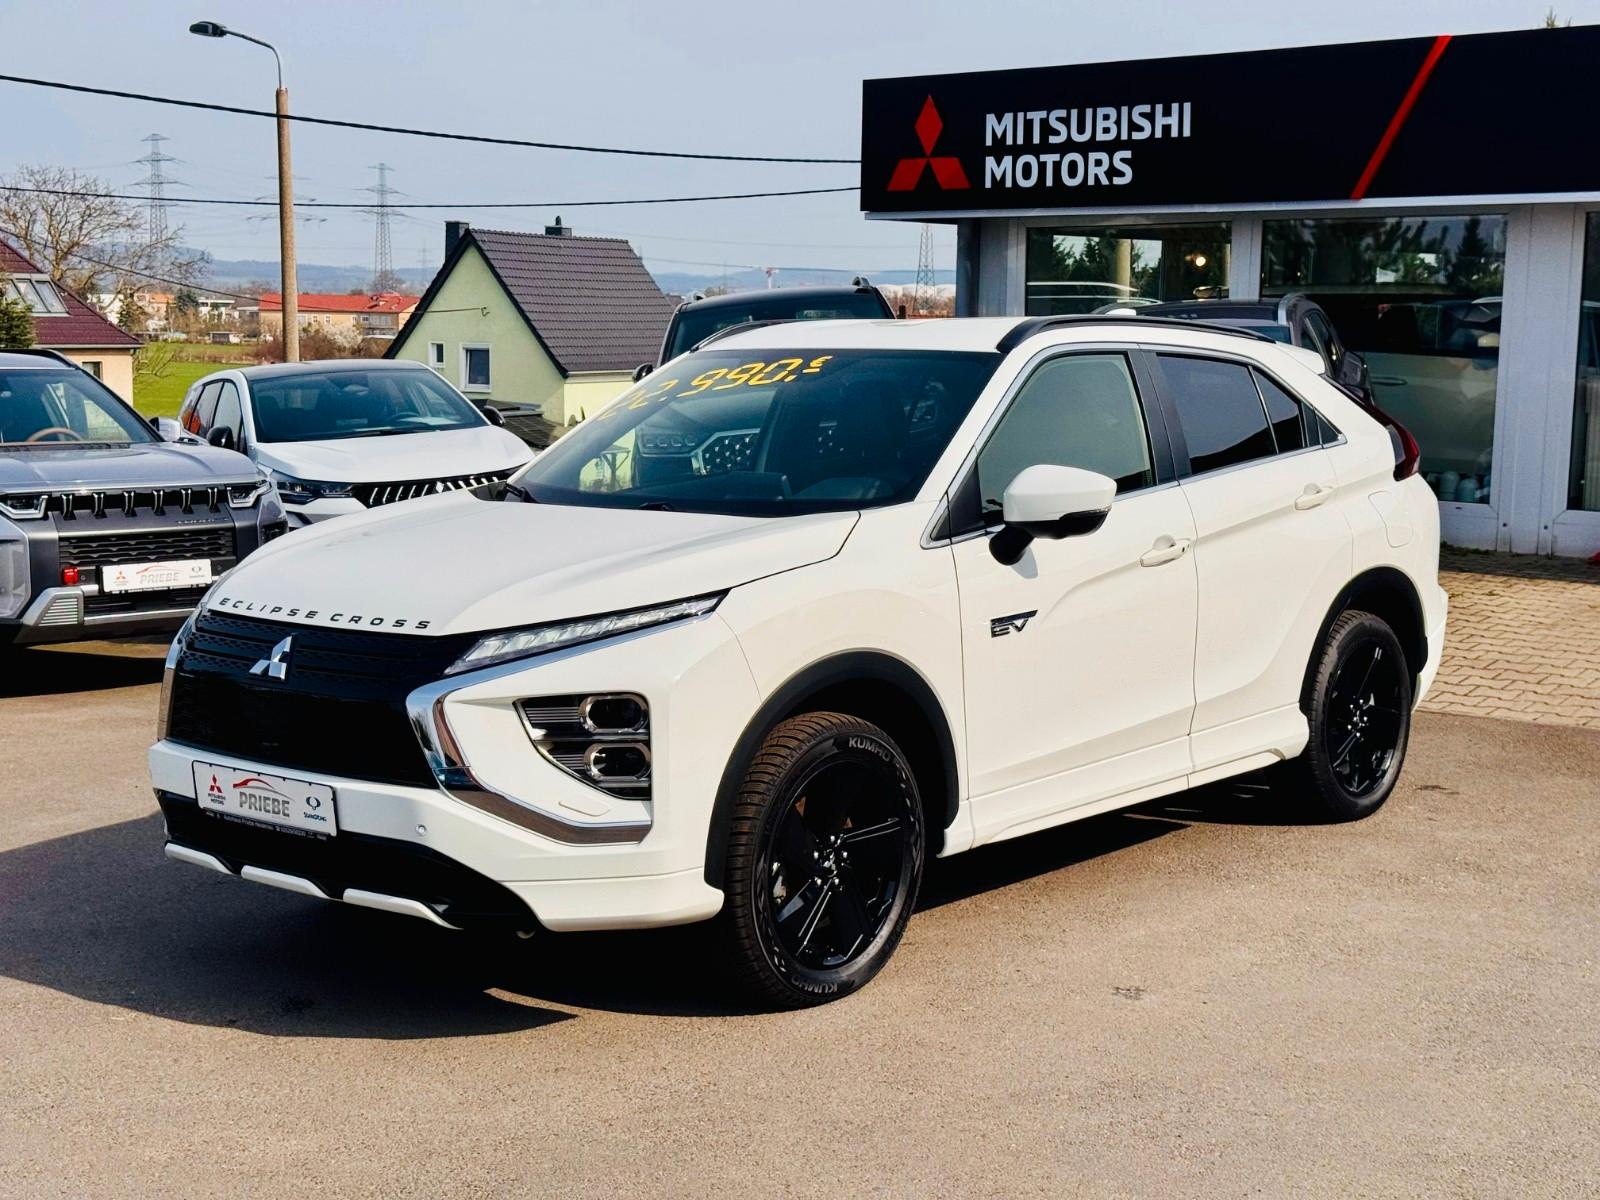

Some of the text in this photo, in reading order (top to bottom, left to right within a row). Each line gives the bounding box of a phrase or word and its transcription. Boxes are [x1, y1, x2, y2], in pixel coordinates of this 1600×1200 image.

[986, 102, 1191, 146] MITSUBISHI
[985, 150, 1133, 189] MOTORS
[218, 597, 432, 630] ECLIPSE CROSS
[848, 736, 892, 762] KUMHO
[239, 791, 291, 818] PRIEBE
[791, 976, 838, 994] KUMHO
